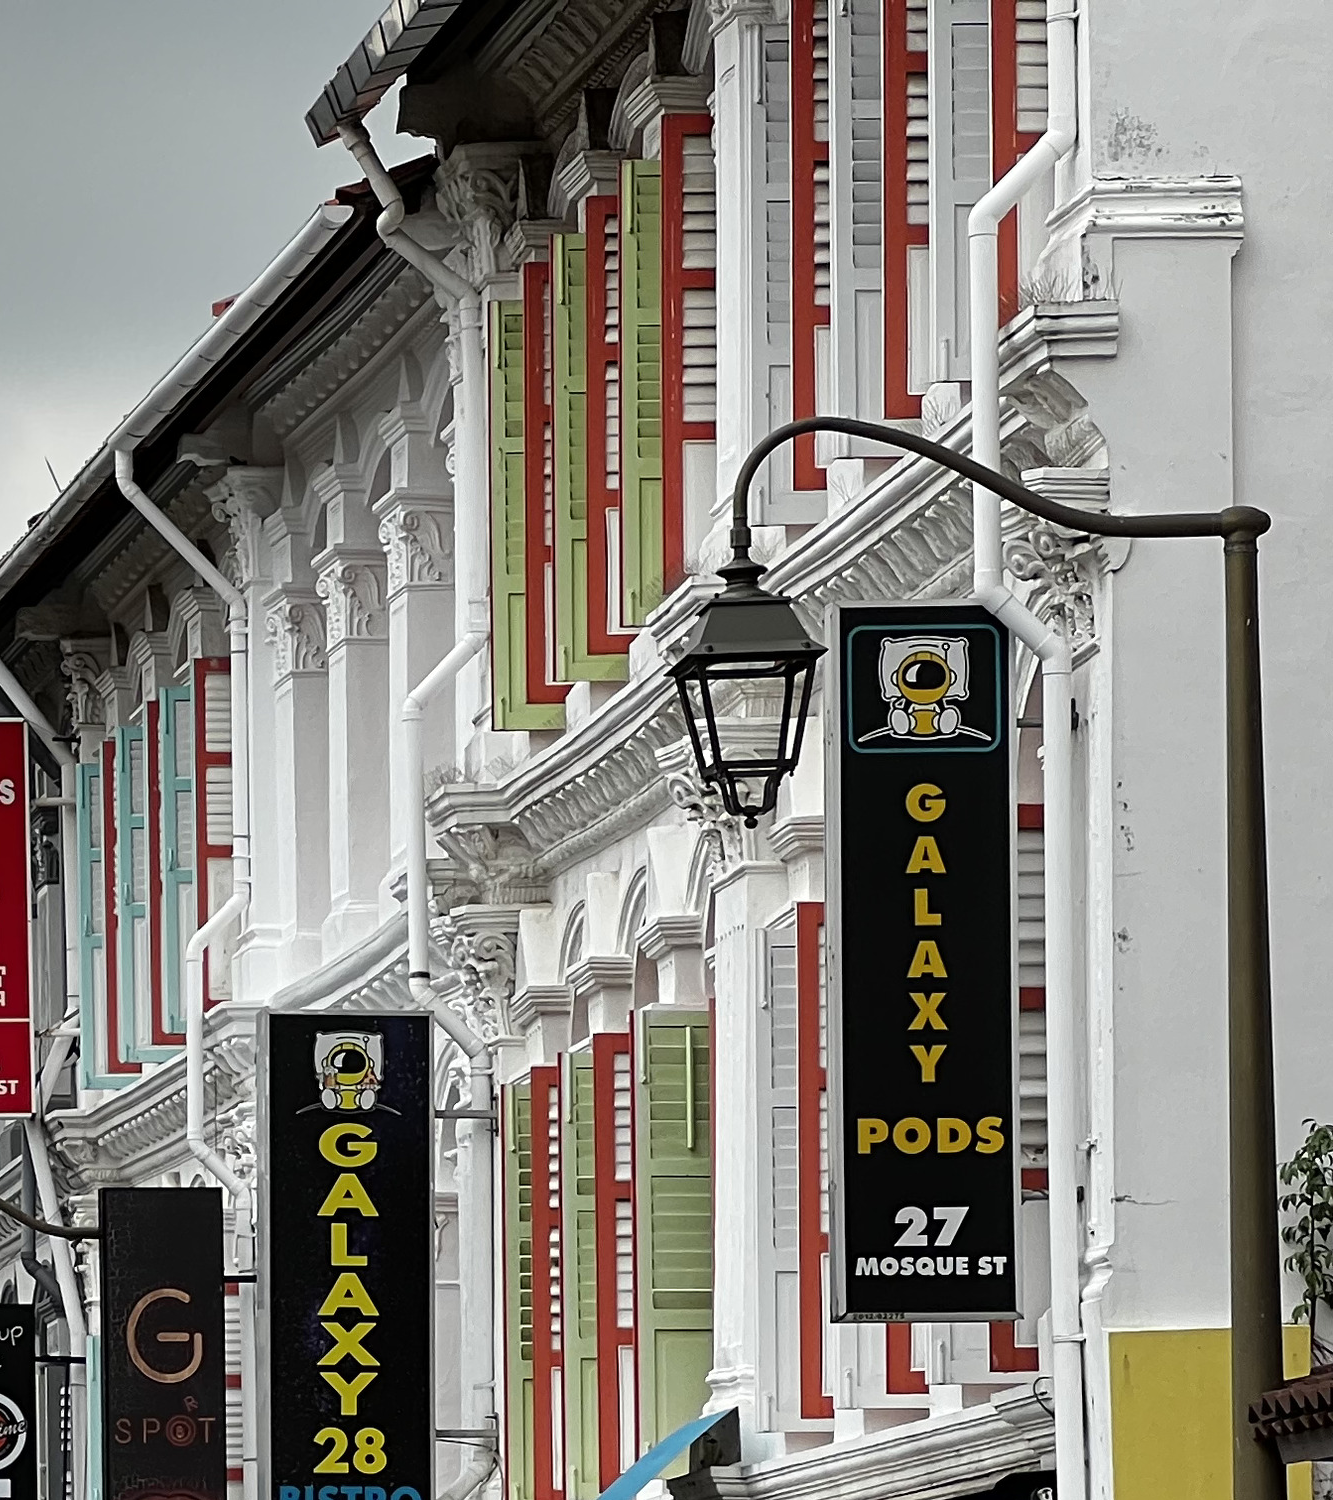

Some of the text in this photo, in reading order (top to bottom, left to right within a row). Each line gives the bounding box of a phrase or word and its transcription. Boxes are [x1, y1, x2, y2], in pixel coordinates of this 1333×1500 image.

[905, 783, 948, 1084] GALAXY
[857, 1116, 1005, 1155] PODS
[894, 1206, 970, 1247] 27
[316, 1122, 380, 1416] GALAXY
[855, 1256, 1007, 1278] MOSQUE ST
[313, 1427, 388, 1474] 28
